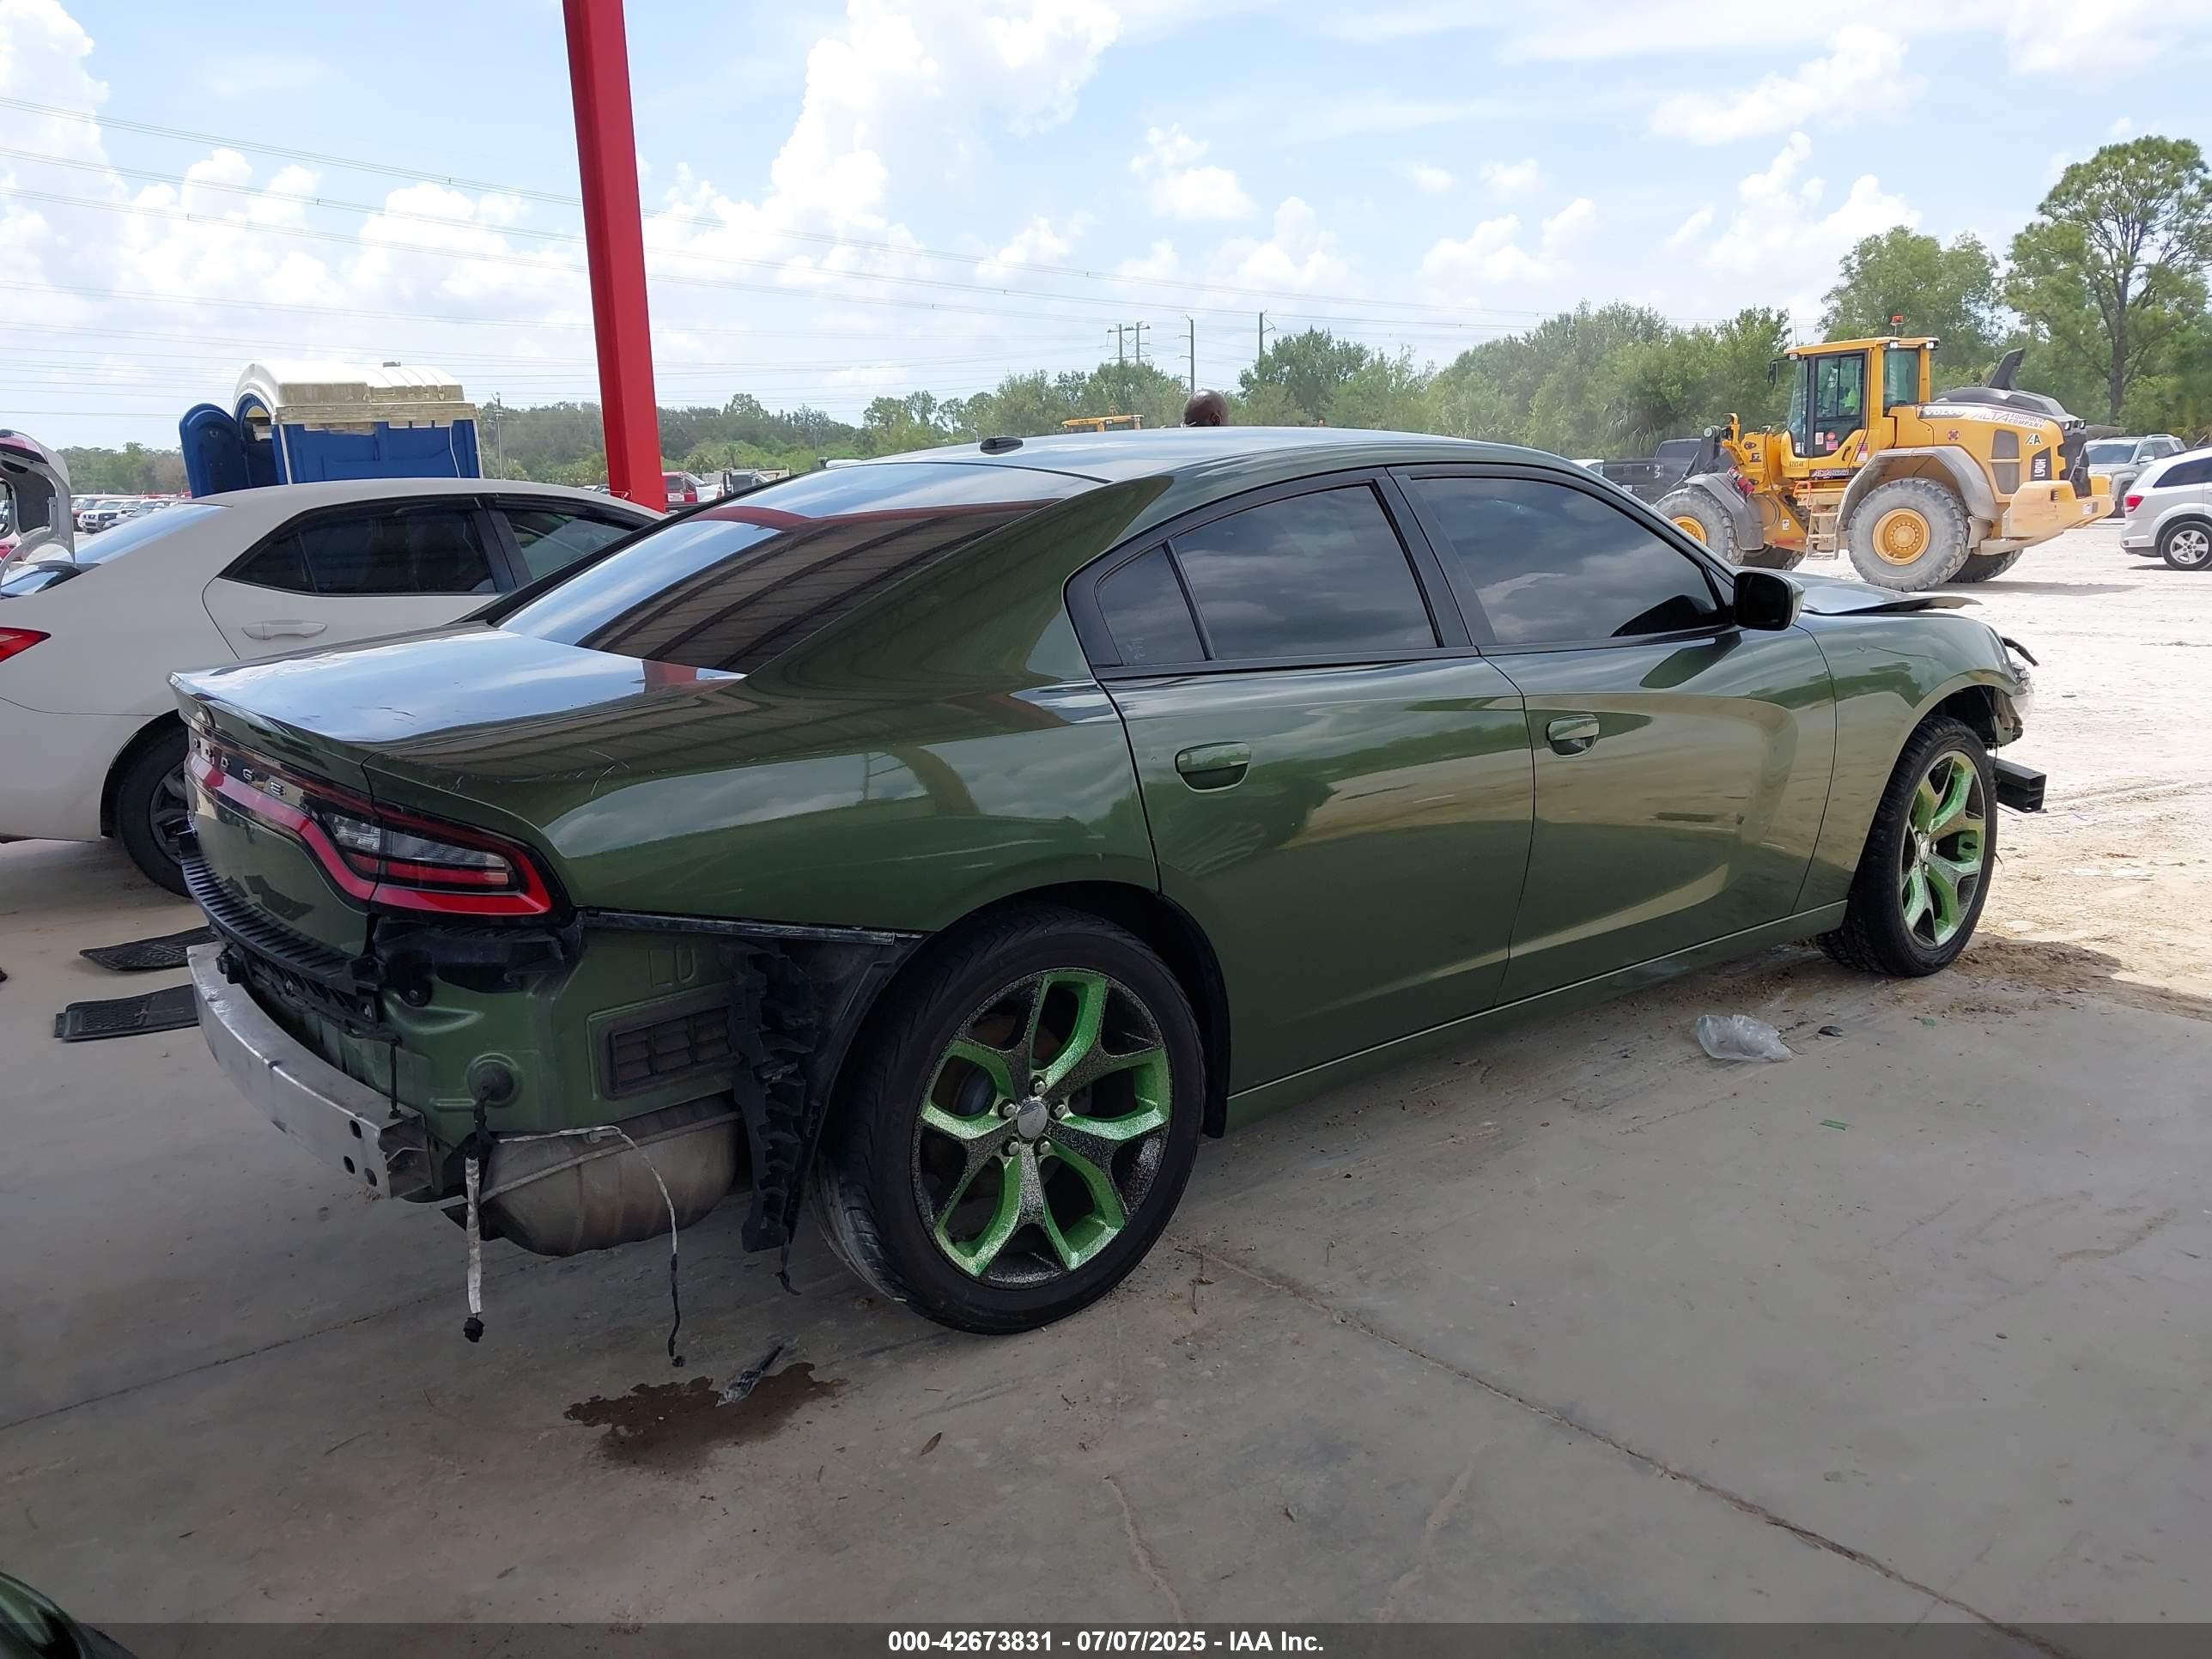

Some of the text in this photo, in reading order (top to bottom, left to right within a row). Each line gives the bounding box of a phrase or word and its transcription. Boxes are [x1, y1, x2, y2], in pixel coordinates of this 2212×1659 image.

[1925, 408, 1964, 416] VOLVO
[1971, 411, 2009, 422] ALTA
[2008, 418, 2044, 428] COMPANY
[2034, 458, 2047, 477] L90H
